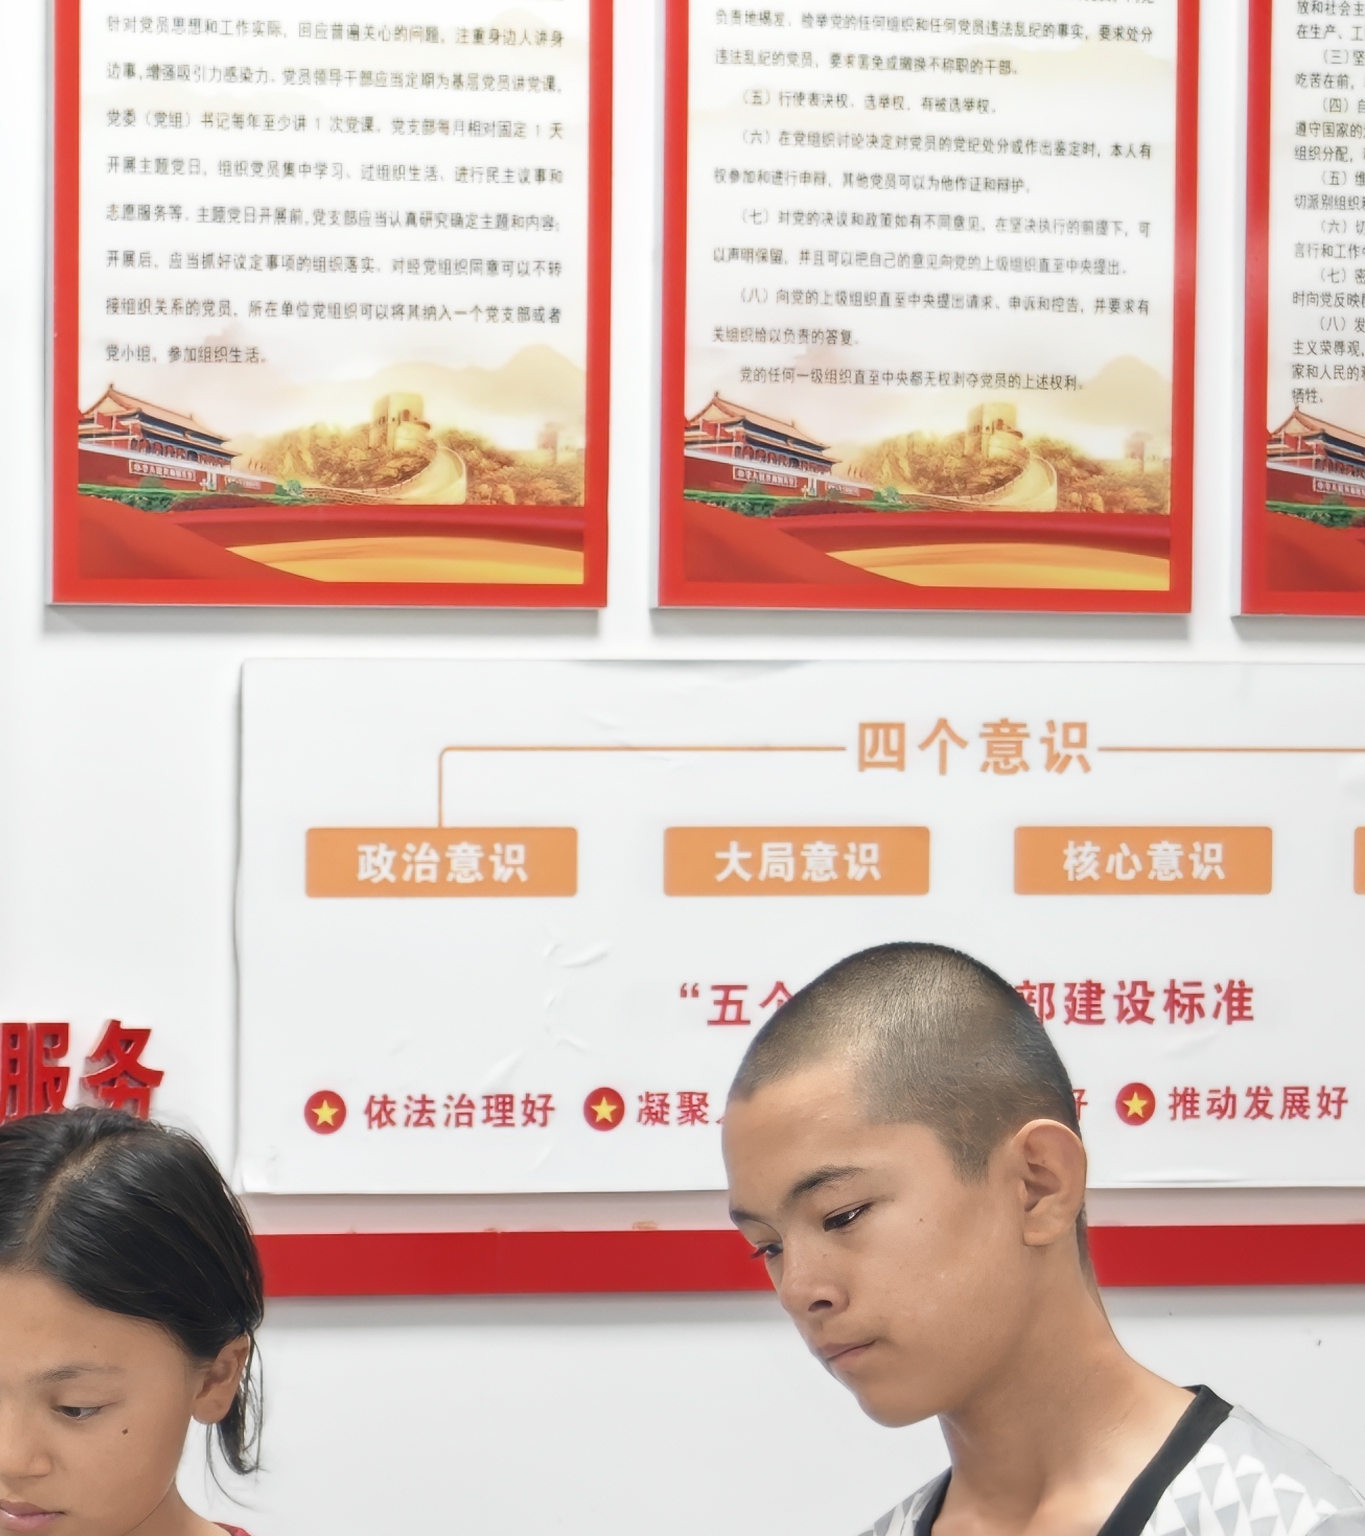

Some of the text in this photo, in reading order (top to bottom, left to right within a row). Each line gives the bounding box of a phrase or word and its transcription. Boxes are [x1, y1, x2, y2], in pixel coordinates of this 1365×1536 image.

[856, 719, 1093, 777] 四个意识
[357, 841, 1227, 884] 政治意识 大局意识 核心意识
[364, 1084, 1348, 1130] 依法治理好 凝聚 推动发展好
